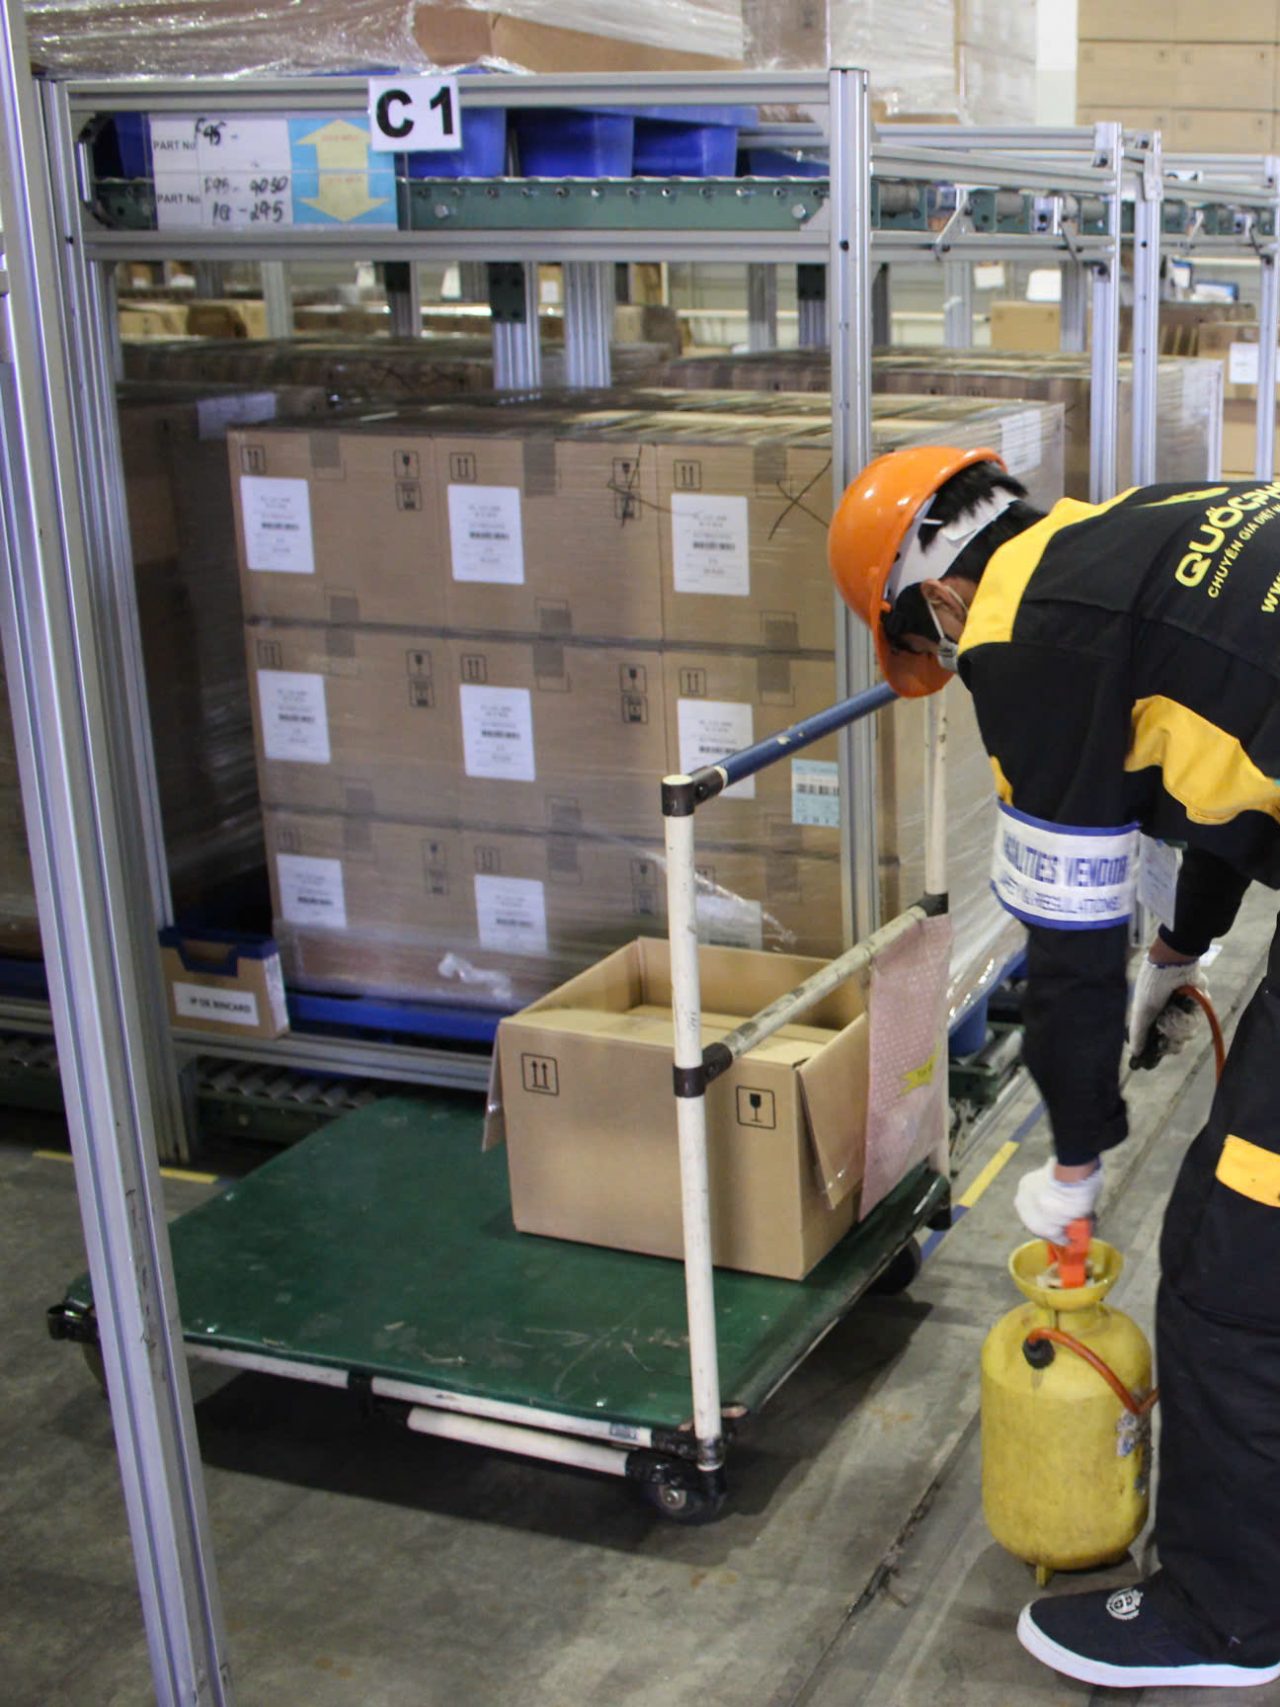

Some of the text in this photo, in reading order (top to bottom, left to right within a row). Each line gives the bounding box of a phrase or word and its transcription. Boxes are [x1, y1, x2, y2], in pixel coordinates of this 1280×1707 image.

[376, 86, 454, 138] C 1
[153, 140, 179, 150] PART
[157, 194, 183, 203] PART
